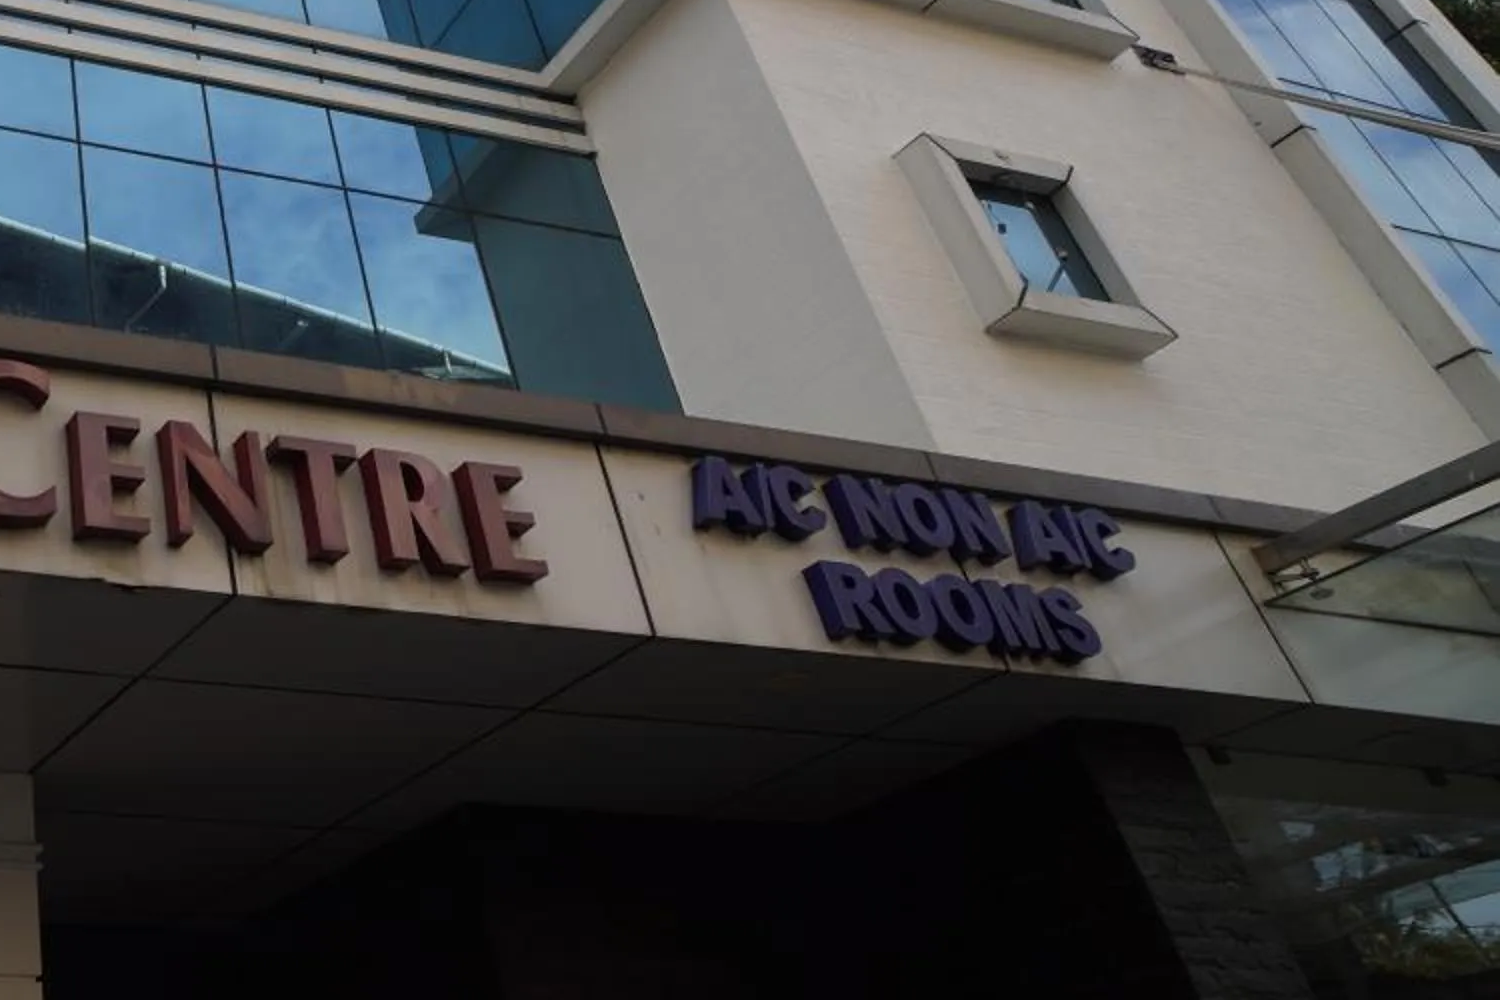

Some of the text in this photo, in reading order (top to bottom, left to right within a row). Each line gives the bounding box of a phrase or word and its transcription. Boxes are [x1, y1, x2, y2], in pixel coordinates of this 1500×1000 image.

[692, 456, 1136, 582] A/C NON A/C
[802, 560, 1102, 664] ROOMS
